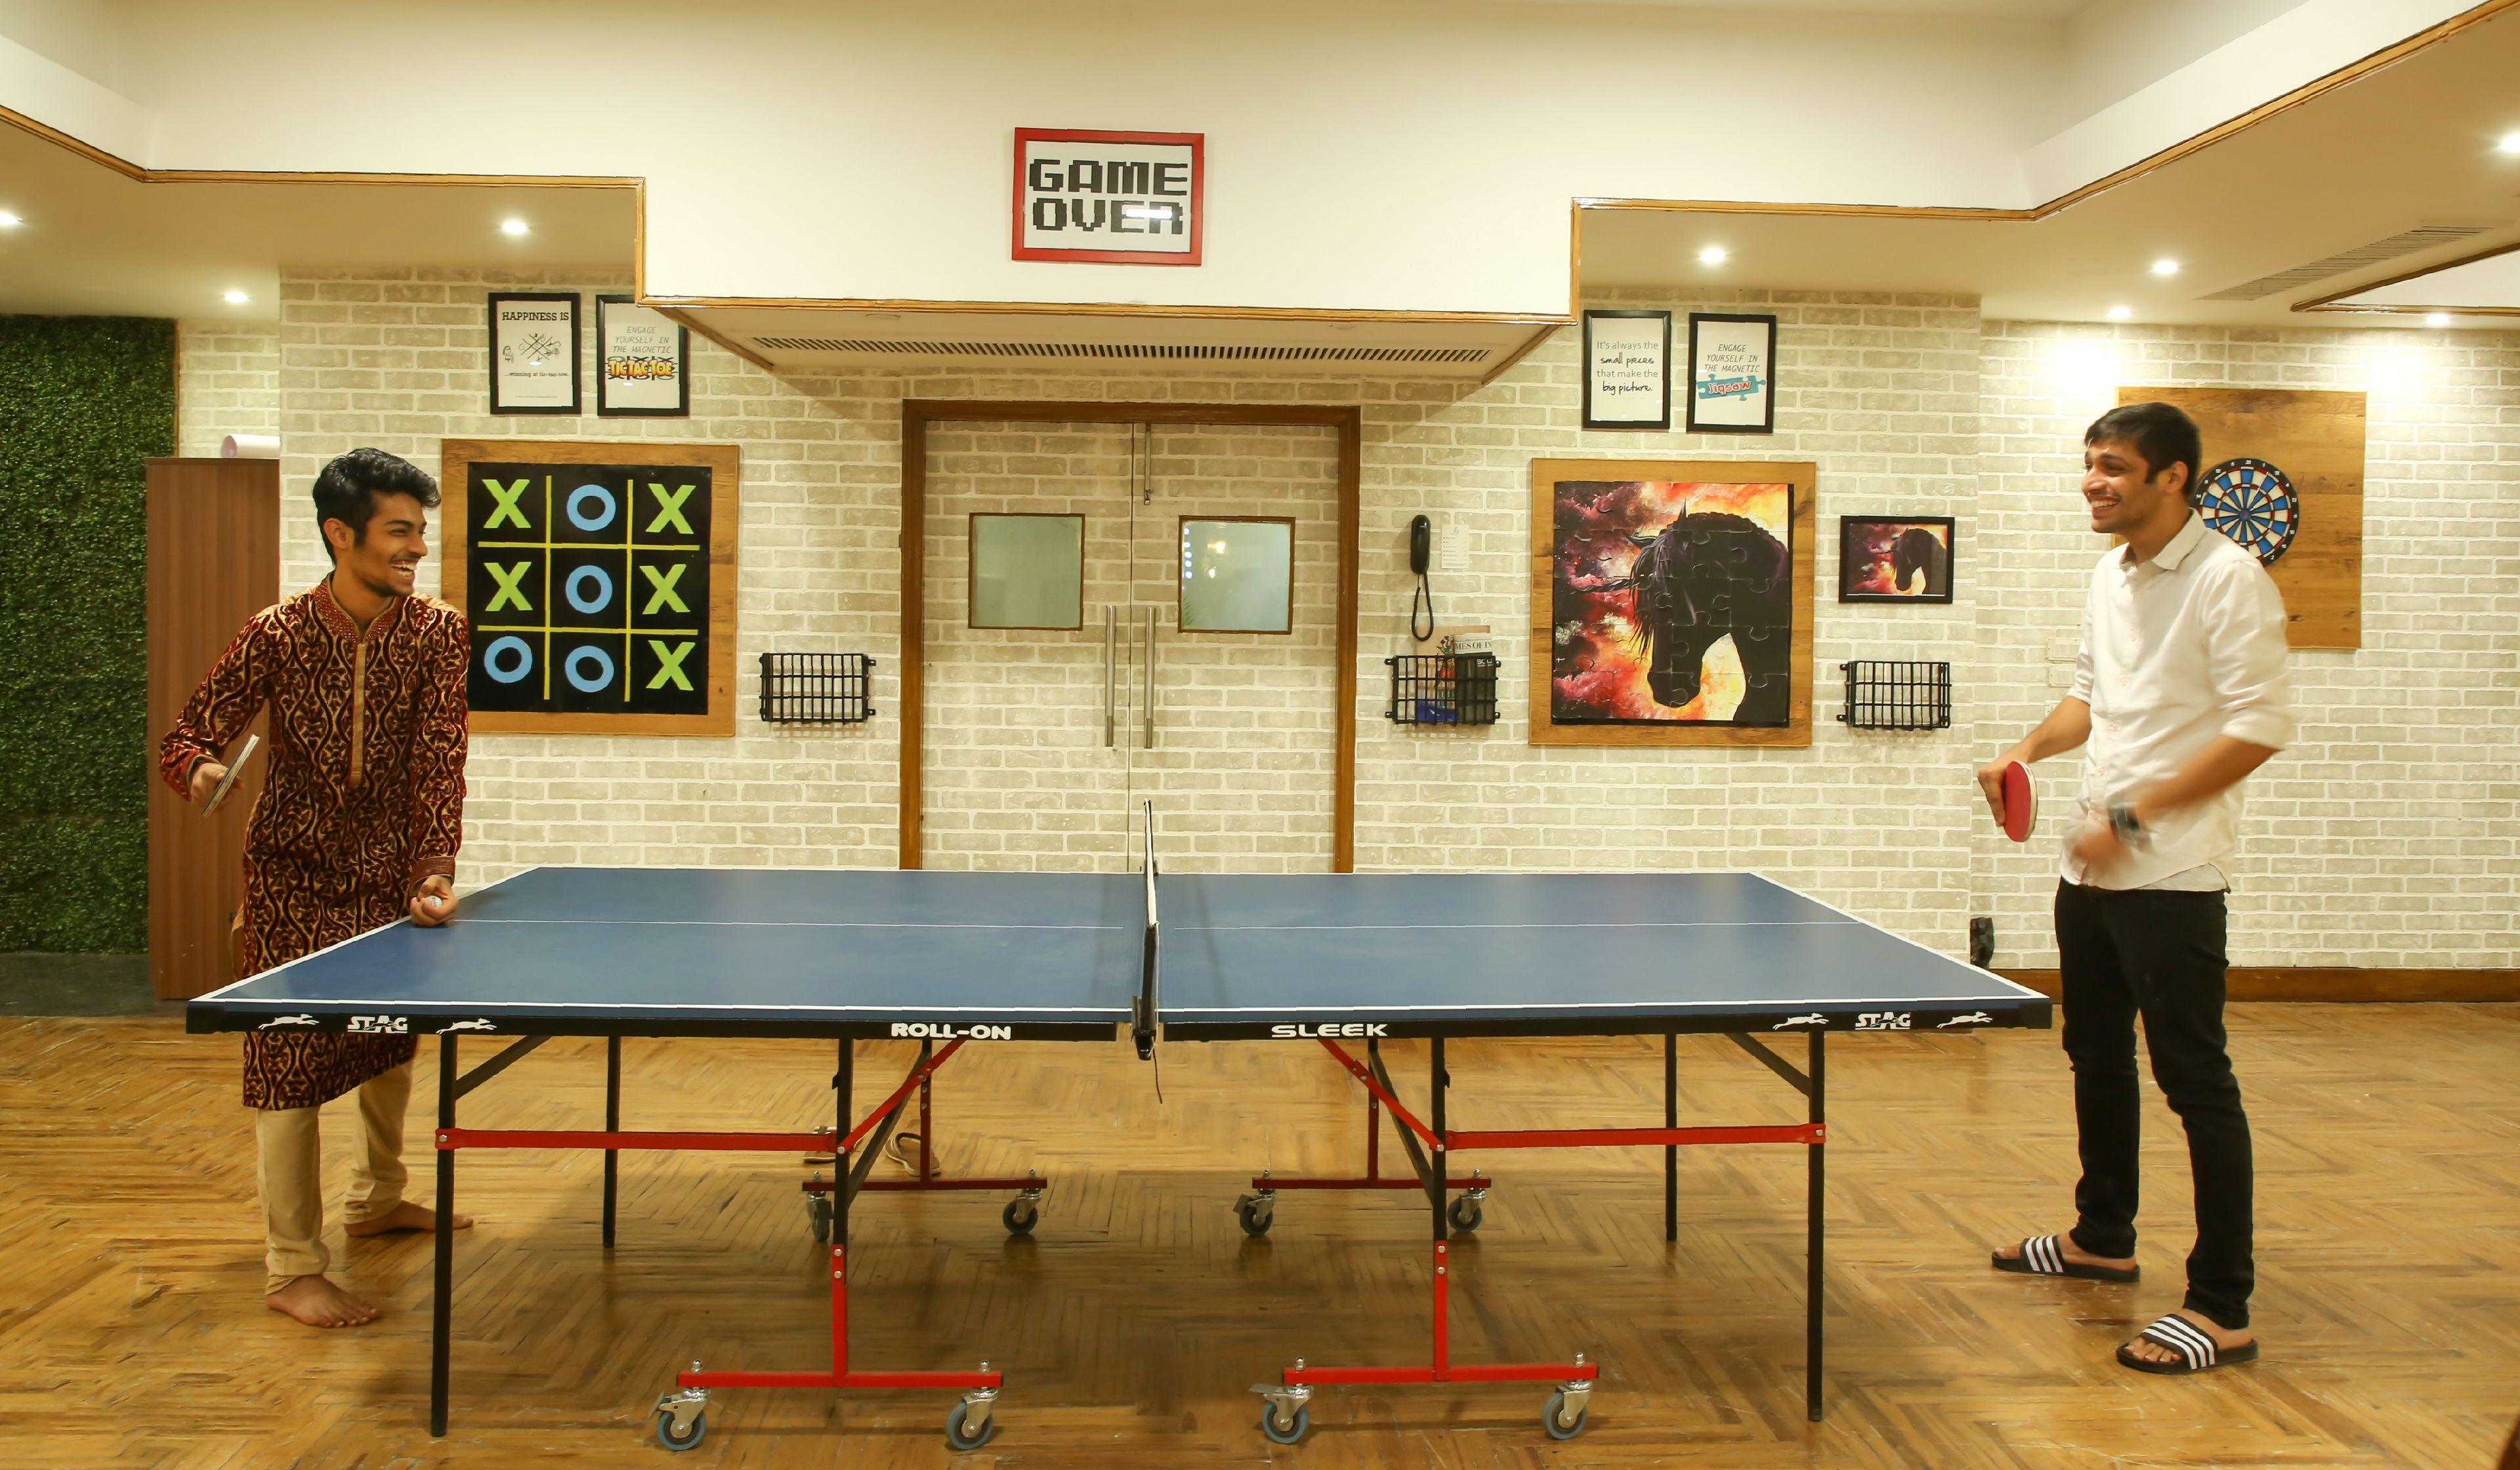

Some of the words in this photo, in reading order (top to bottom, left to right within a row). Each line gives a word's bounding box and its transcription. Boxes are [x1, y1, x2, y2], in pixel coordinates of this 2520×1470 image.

[1029, 158, 1188, 196] GAME
[1033, 198, 1183, 234] OVER
[502, 312, 557, 321] HAPPINESS
[560, 312, 569, 321] IS
[1597, 341, 1610, 349] It's
[1612, 341, 1641, 351] always
[1644, 341, 1658, 350] the
[1601, 352, 1623, 364] small
[1626, 355, 1654, 368] pieces
[1706, 354, 1744, 362] YOURSELF
[1748, 354, 1758, 363] IN
[1597, 369, 1615, 378] that
[1617, 369, 1641, 378] make
[1644, 369, 1658, 378] the
[1704, 364, 1717, 372] THE
[1721, 364, 1760, 373] MAGNETIC
[1603, 380, 1616, 396] big
[1618, 381, 1652, 395] picture.
[1708, 380, 1752, 395] Jigsaw
[346, 1015, 408, 1034] STAG
[1855, 1011, 1910, 1030] STAG
[891, 1023, 1011, 1040] ROLL-ON
[1271, 1024, 1388, 1038] SLEEK
